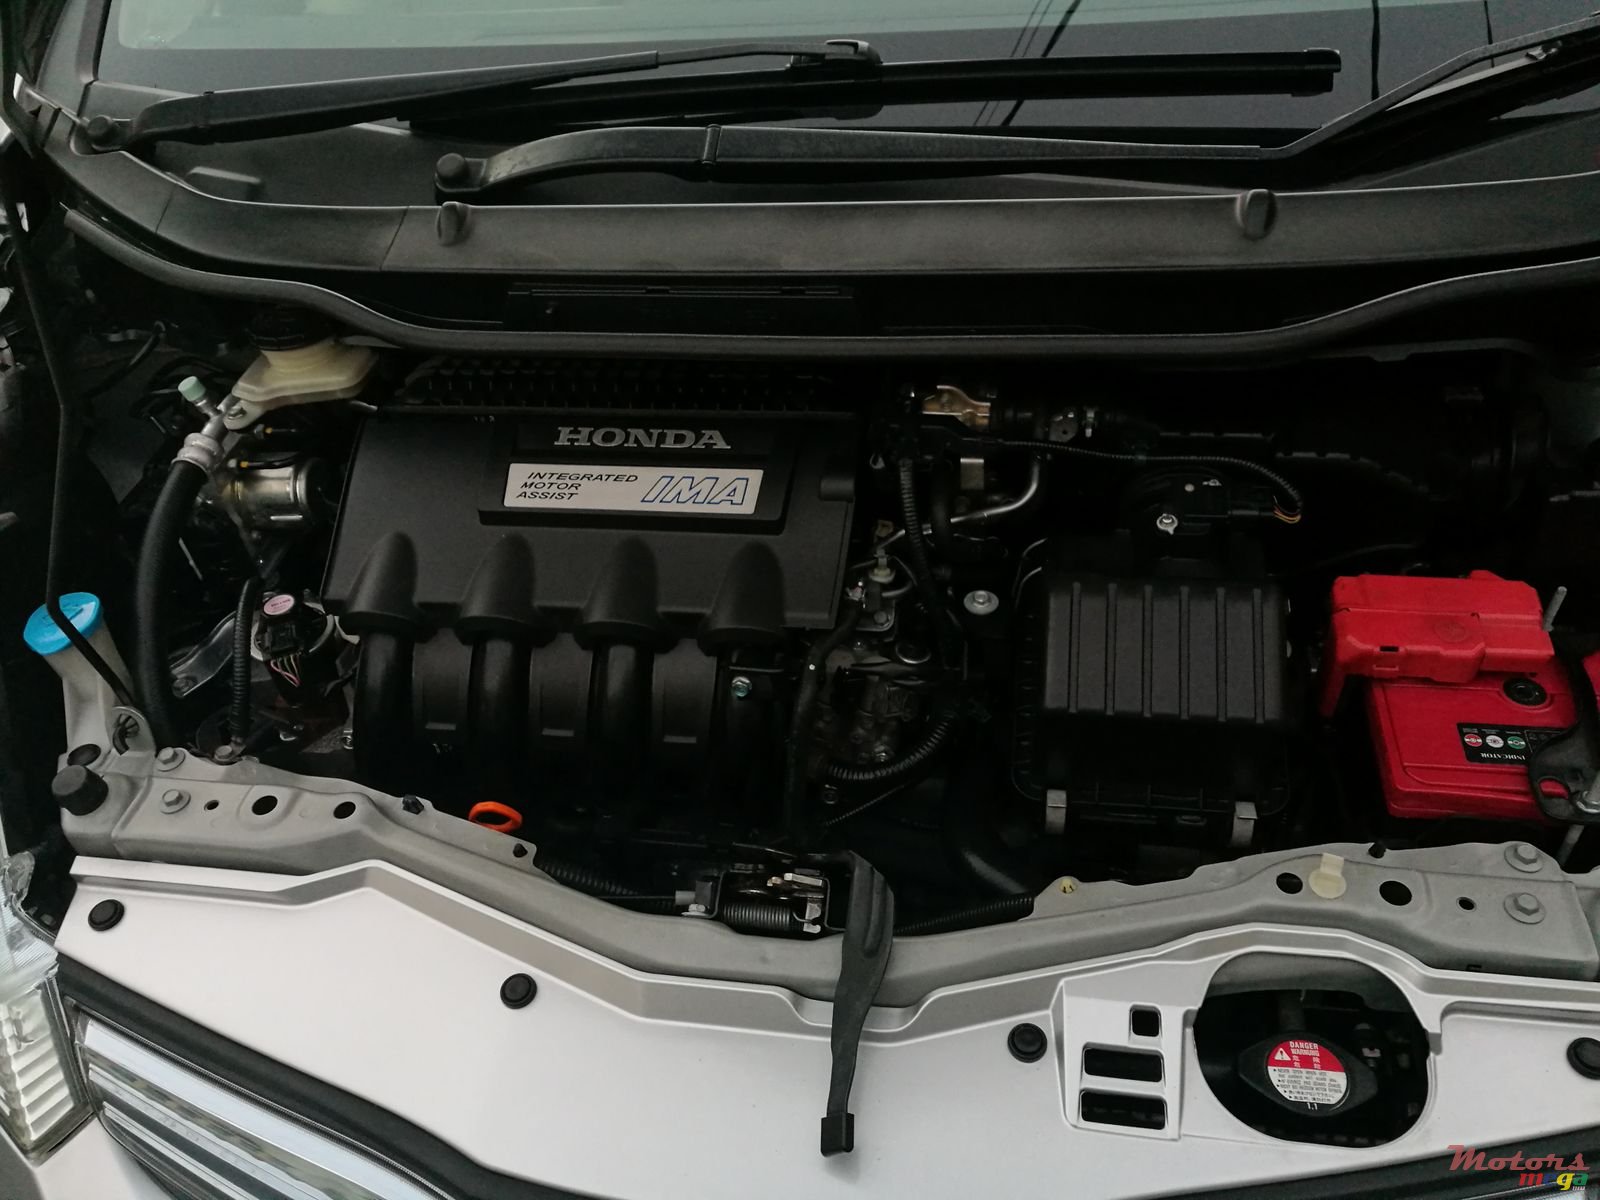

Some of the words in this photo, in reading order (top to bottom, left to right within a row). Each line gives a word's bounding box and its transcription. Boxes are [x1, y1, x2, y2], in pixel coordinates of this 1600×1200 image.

[554, 426, 732, 450] HONDA
[526, 471, 639, 483] INTEGRATED
[520, 481, 582, 491] MOTOR
[640, 475, 750, 506] IMA
[516, 491, 579, 501] ASSIST
[1480, 752, 1526, 761] INDICATOR
[1289, 1041, 1319, 1050] DANGER
[1307, 1102, 1318, 1110] 1.1
